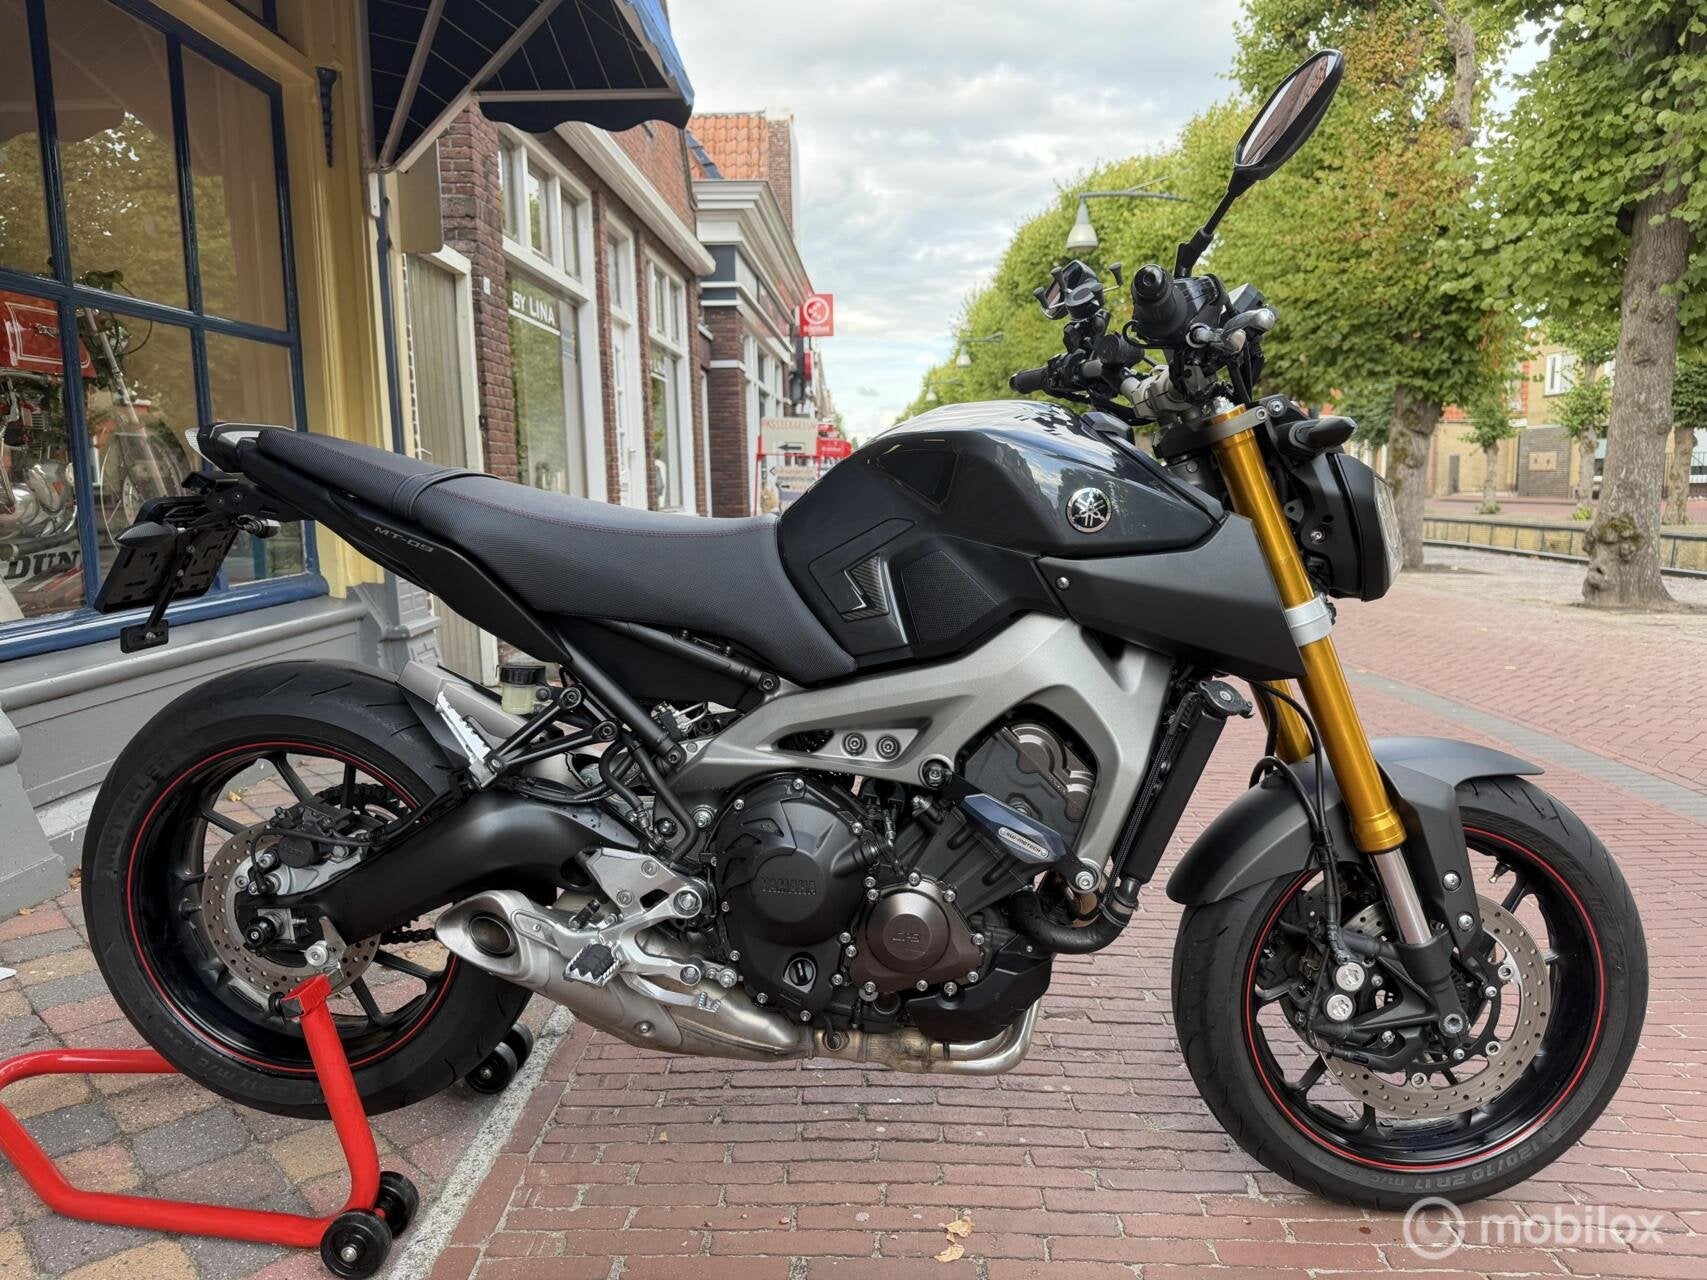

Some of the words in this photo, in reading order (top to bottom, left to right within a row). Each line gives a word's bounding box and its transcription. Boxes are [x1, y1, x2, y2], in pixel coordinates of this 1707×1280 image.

[512, 290, 526, 311] BY
[529, 295, 556, 326] LINA
[374, 526, 434, 552] MT-09
[760, 878, 817, 896] YAMAHA
